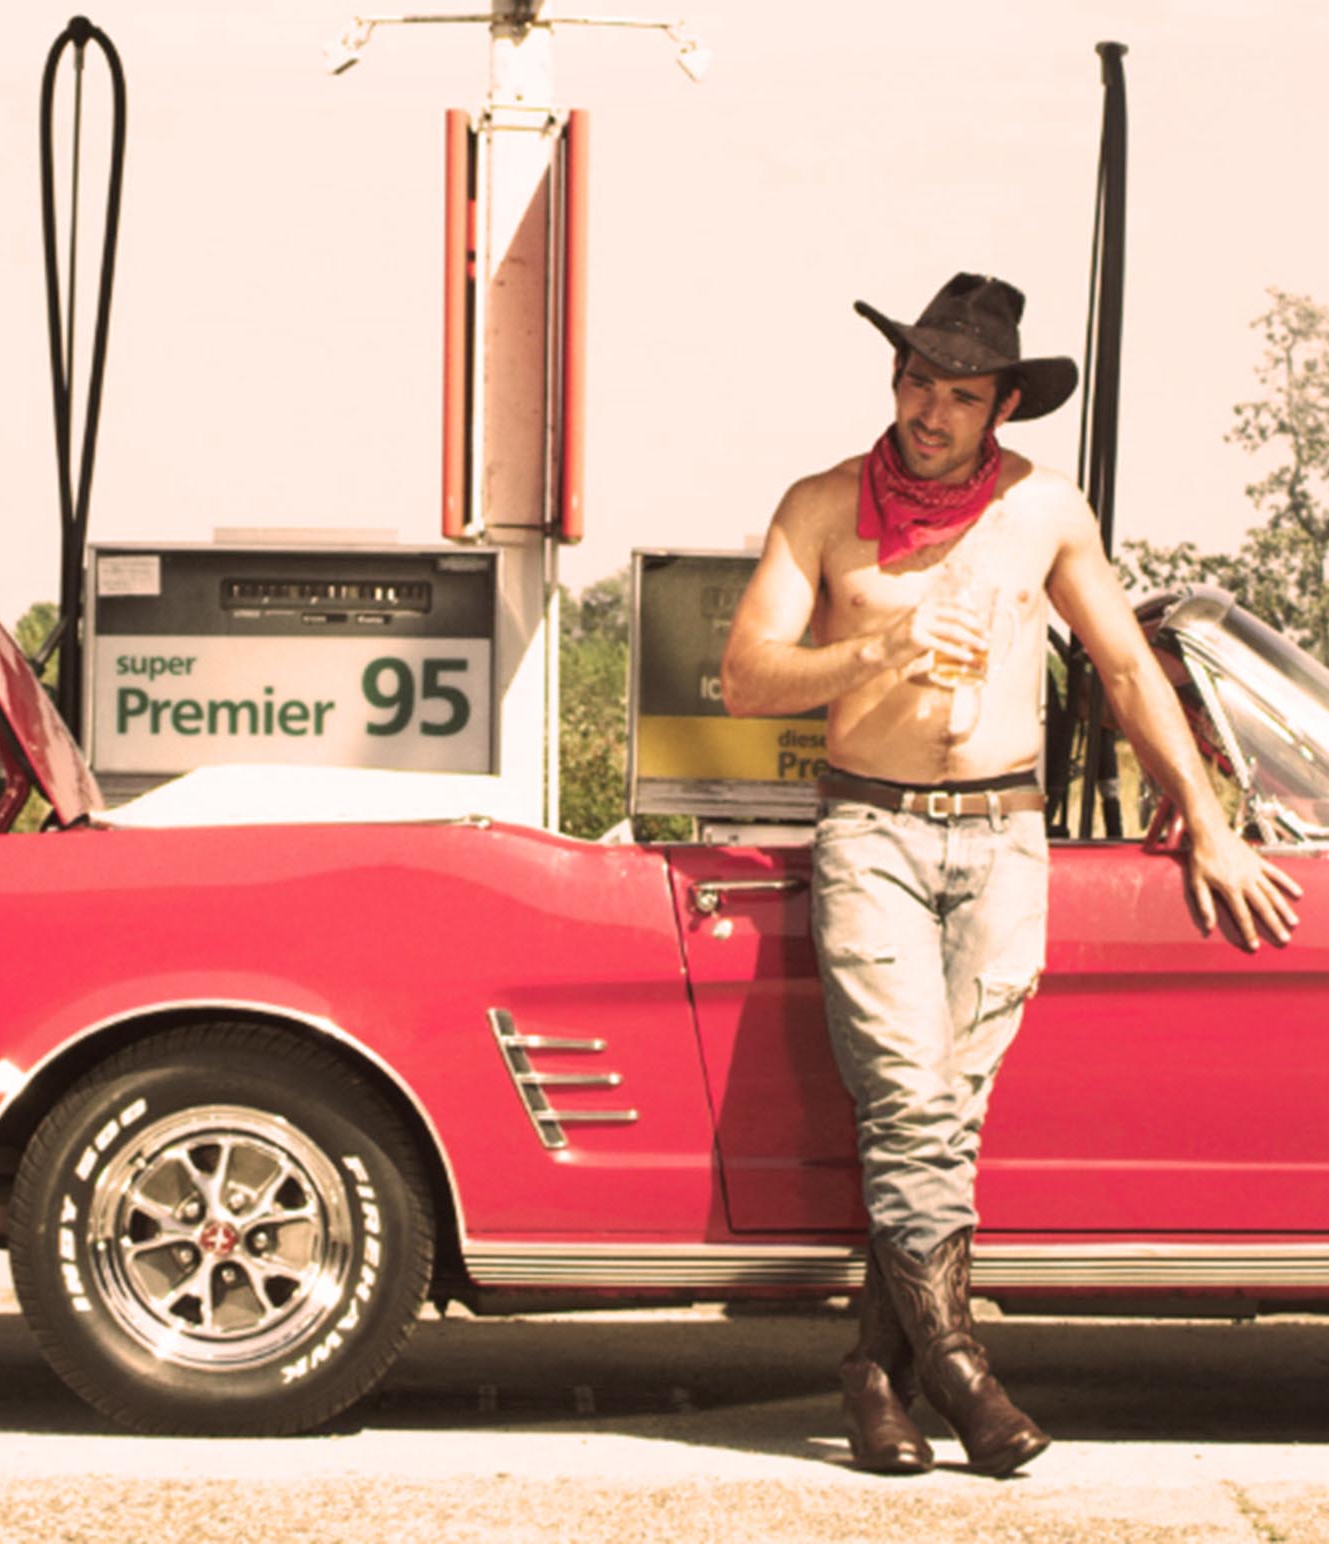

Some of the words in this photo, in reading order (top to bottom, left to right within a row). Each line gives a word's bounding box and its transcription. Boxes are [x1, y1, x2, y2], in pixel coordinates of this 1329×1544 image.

[116, 654, 197, 680] super
[116, 686, 335, 736] Premier
[361, 657, 472, 737] 95
[280, 1155, 381, 1385] FIREHAWK
